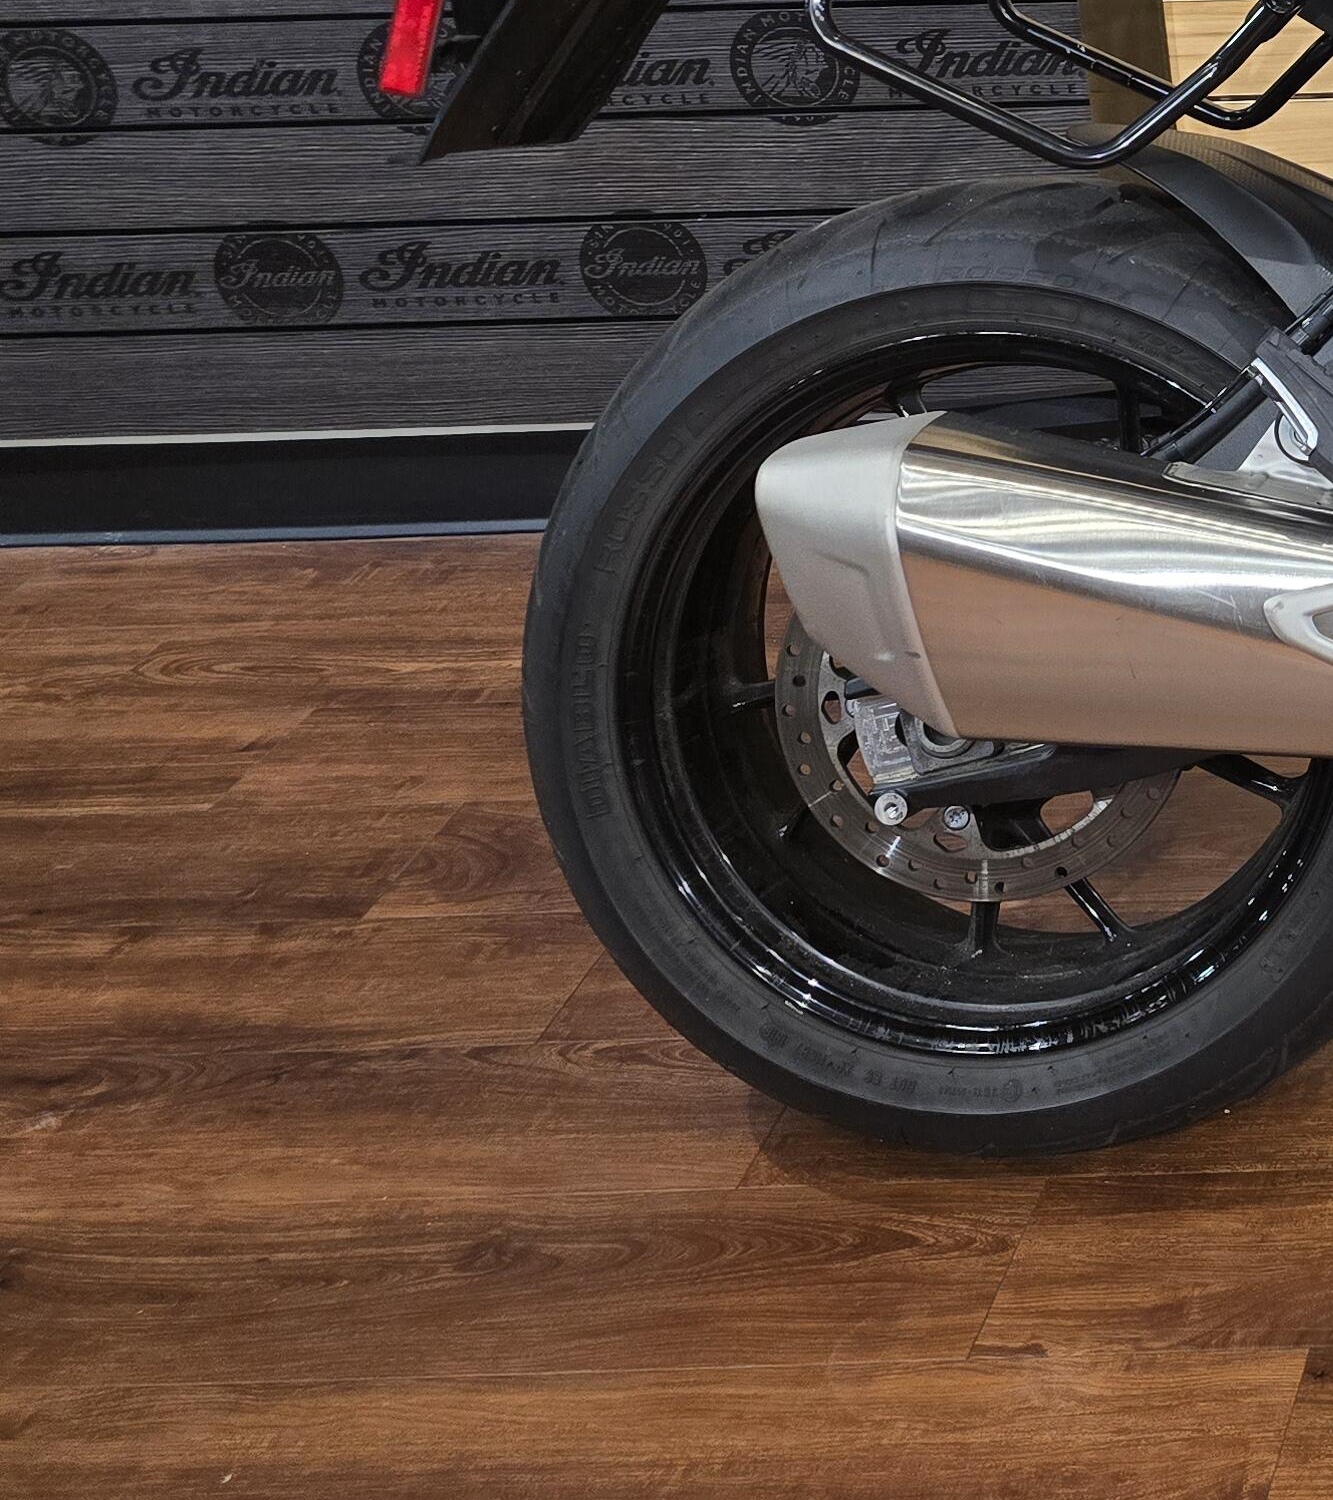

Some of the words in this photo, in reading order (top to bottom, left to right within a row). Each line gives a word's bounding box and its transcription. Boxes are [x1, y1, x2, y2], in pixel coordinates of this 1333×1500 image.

[132, 48, 337, 101] Indian
[147, 103, 340, 118] MOTORCYCLE
[0, 251, 198, 301] Indian
[219, 261, 335, 289] Indian
[359, 241, 562, 291] Indian
[584, 249, 701, 278] Indian
[8, 302, 198, 319] MOTORCYCLE
[372, 292, 560, 308] MOTORCYCLE
